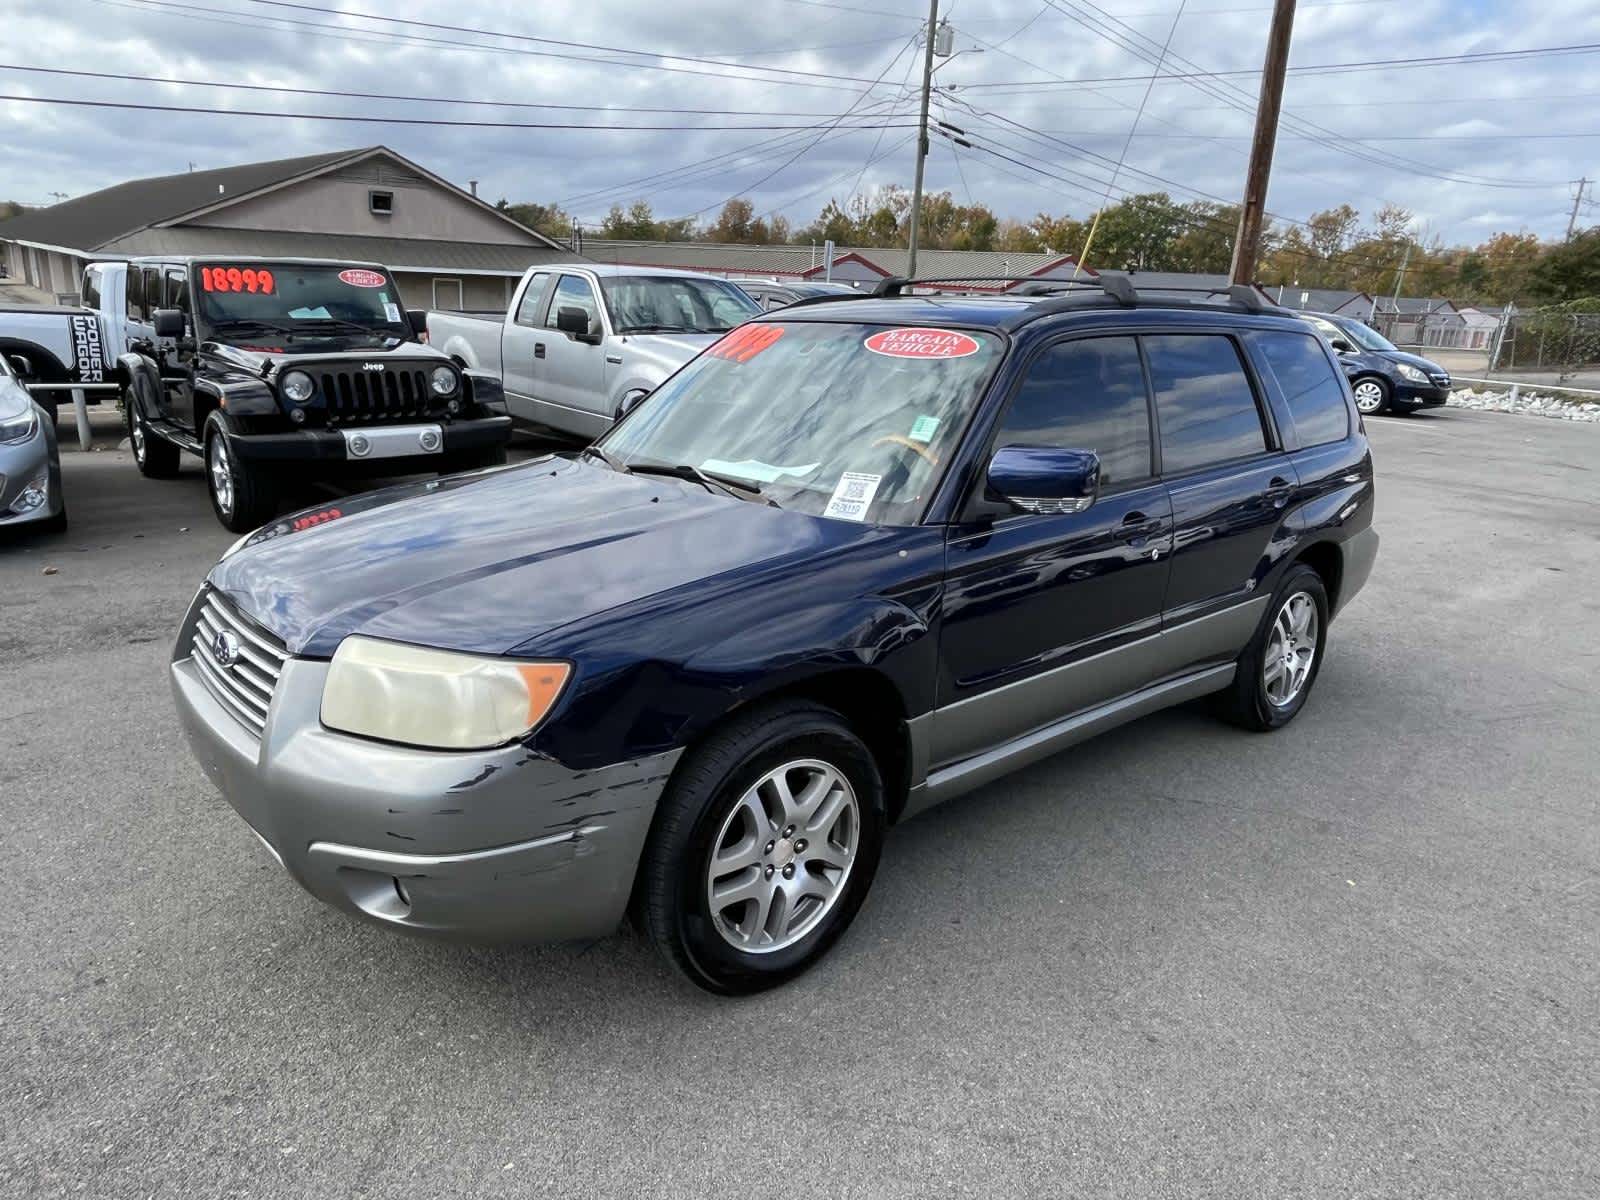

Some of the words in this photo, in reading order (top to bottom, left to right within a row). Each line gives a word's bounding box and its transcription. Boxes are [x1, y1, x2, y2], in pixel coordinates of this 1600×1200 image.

[201, 266, 273, 295] 18999
[73, 316, 91, 382] WAGON
[84, 316, 103, 382] POWER
[878, 341, 957, 355] VEHICLE
[883, 331, 962, 346] BARGAIN
[362, 362, 384, 372] Jeep
